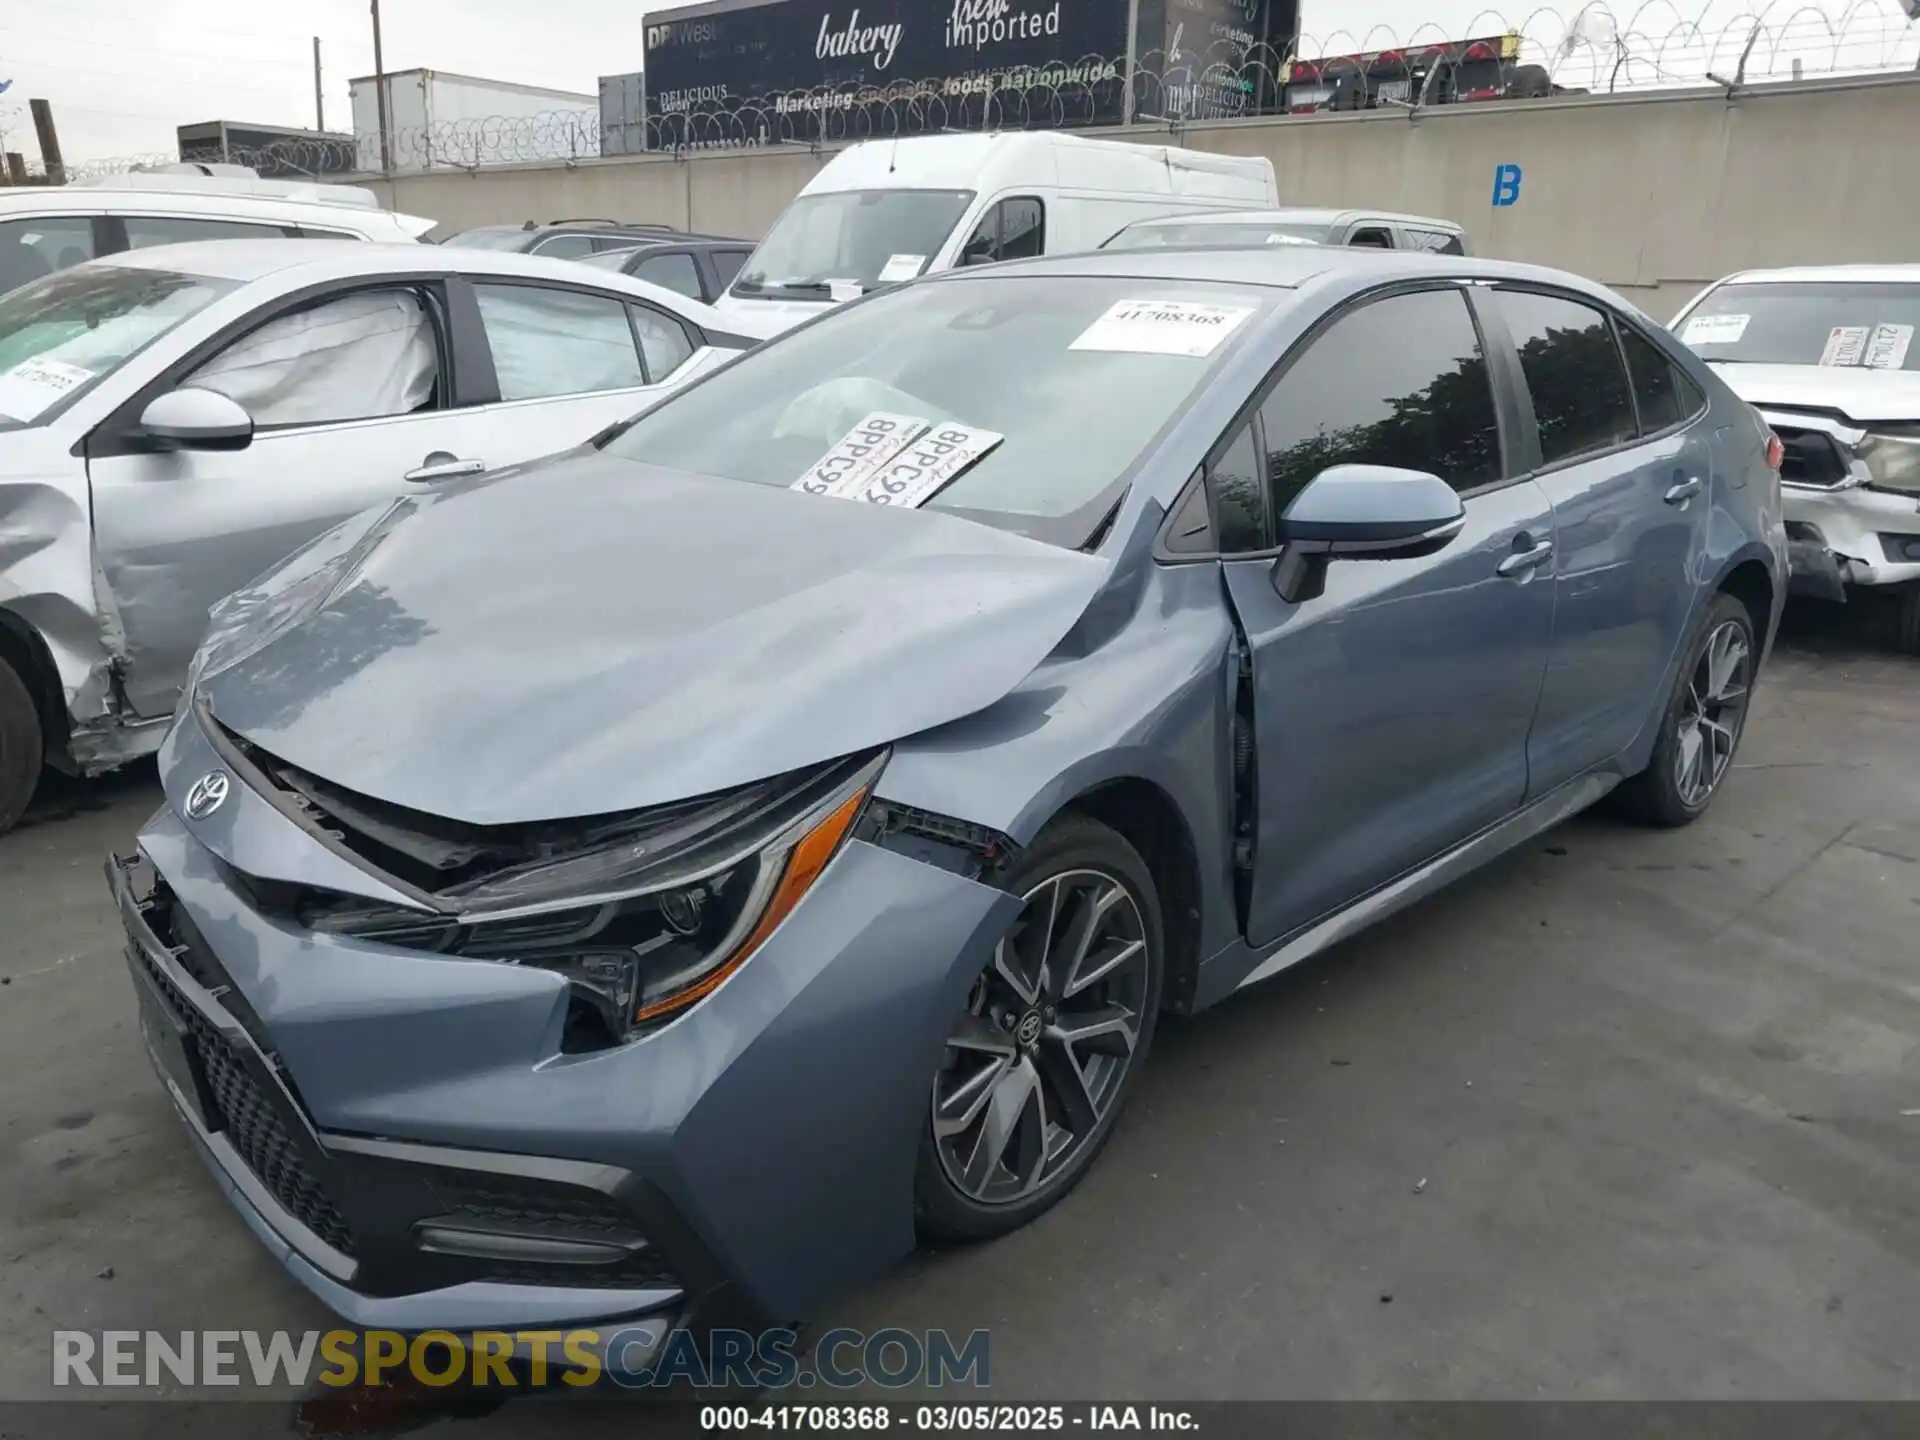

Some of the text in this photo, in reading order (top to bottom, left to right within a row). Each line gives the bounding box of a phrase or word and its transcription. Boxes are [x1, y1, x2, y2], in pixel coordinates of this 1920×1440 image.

[815, 8, 904, 71] bakery
[945, 1, 1061, 51] imported
[660, 84, 728, 105] DELICIOUS
[776, 91, 854, 114] Marketing
[943, 75, 995, 97] foods
[1000, 62, 1116, 91] nationwide
[1492, 164, 1521, 206] B
